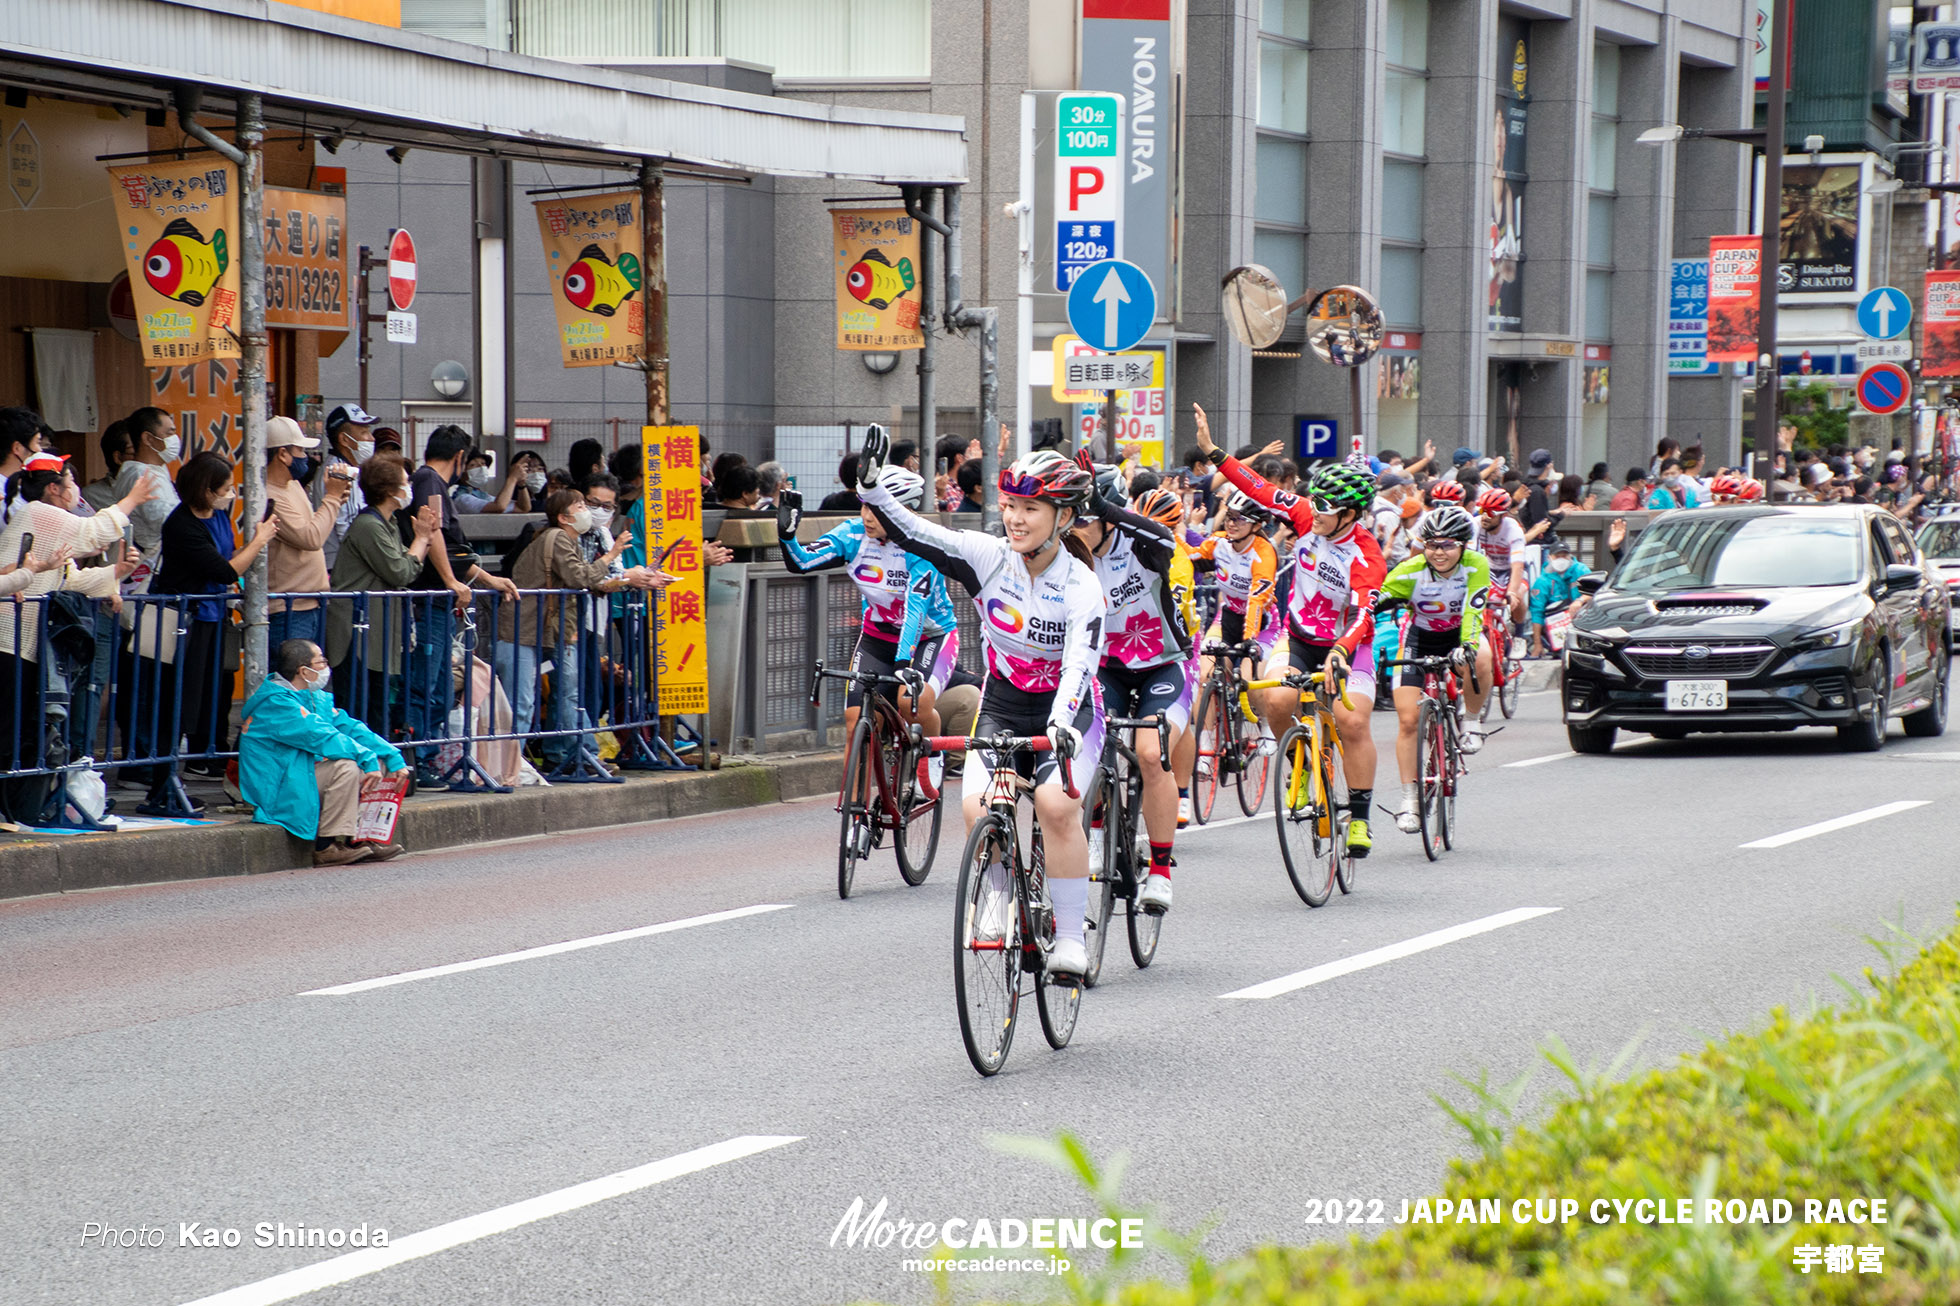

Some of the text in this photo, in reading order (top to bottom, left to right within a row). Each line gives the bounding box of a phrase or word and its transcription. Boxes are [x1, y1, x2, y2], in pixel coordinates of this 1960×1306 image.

[1071, 106, 1105, 124] 30分
[1131, 37, 1156, 184] NOMURA
[1066, 131, 1109, 149] 100円
[1069, 166, 1105, 211] P
[265, 208, 340, 262] 大通り店
[1064, 241, 1108, 259] 120分
[1715, 249, 1759, 261] JAPAN
[1714, 262, 1739, 274] CUP
[1803, 264, 1852, 275] Dining Bar
[1802, 276, 1853, 287] SUKATTO
[1929, 293, 1950, 302] CUP
[1069, 363, 1151, 382] 自転車を除く
[1081, 416, 1156, 440] 900円
[1307, 424, 1332, 454] P
[1274, 489, 1300, 509] 3
[912, 572, 933, 598] 4
[1251, 578, 1273, 596] 7
[1470, 586, 1489, 609] 6
[1086, 616, 1103, 651] 1
[1681, 692, 1724, 707] 67-63
